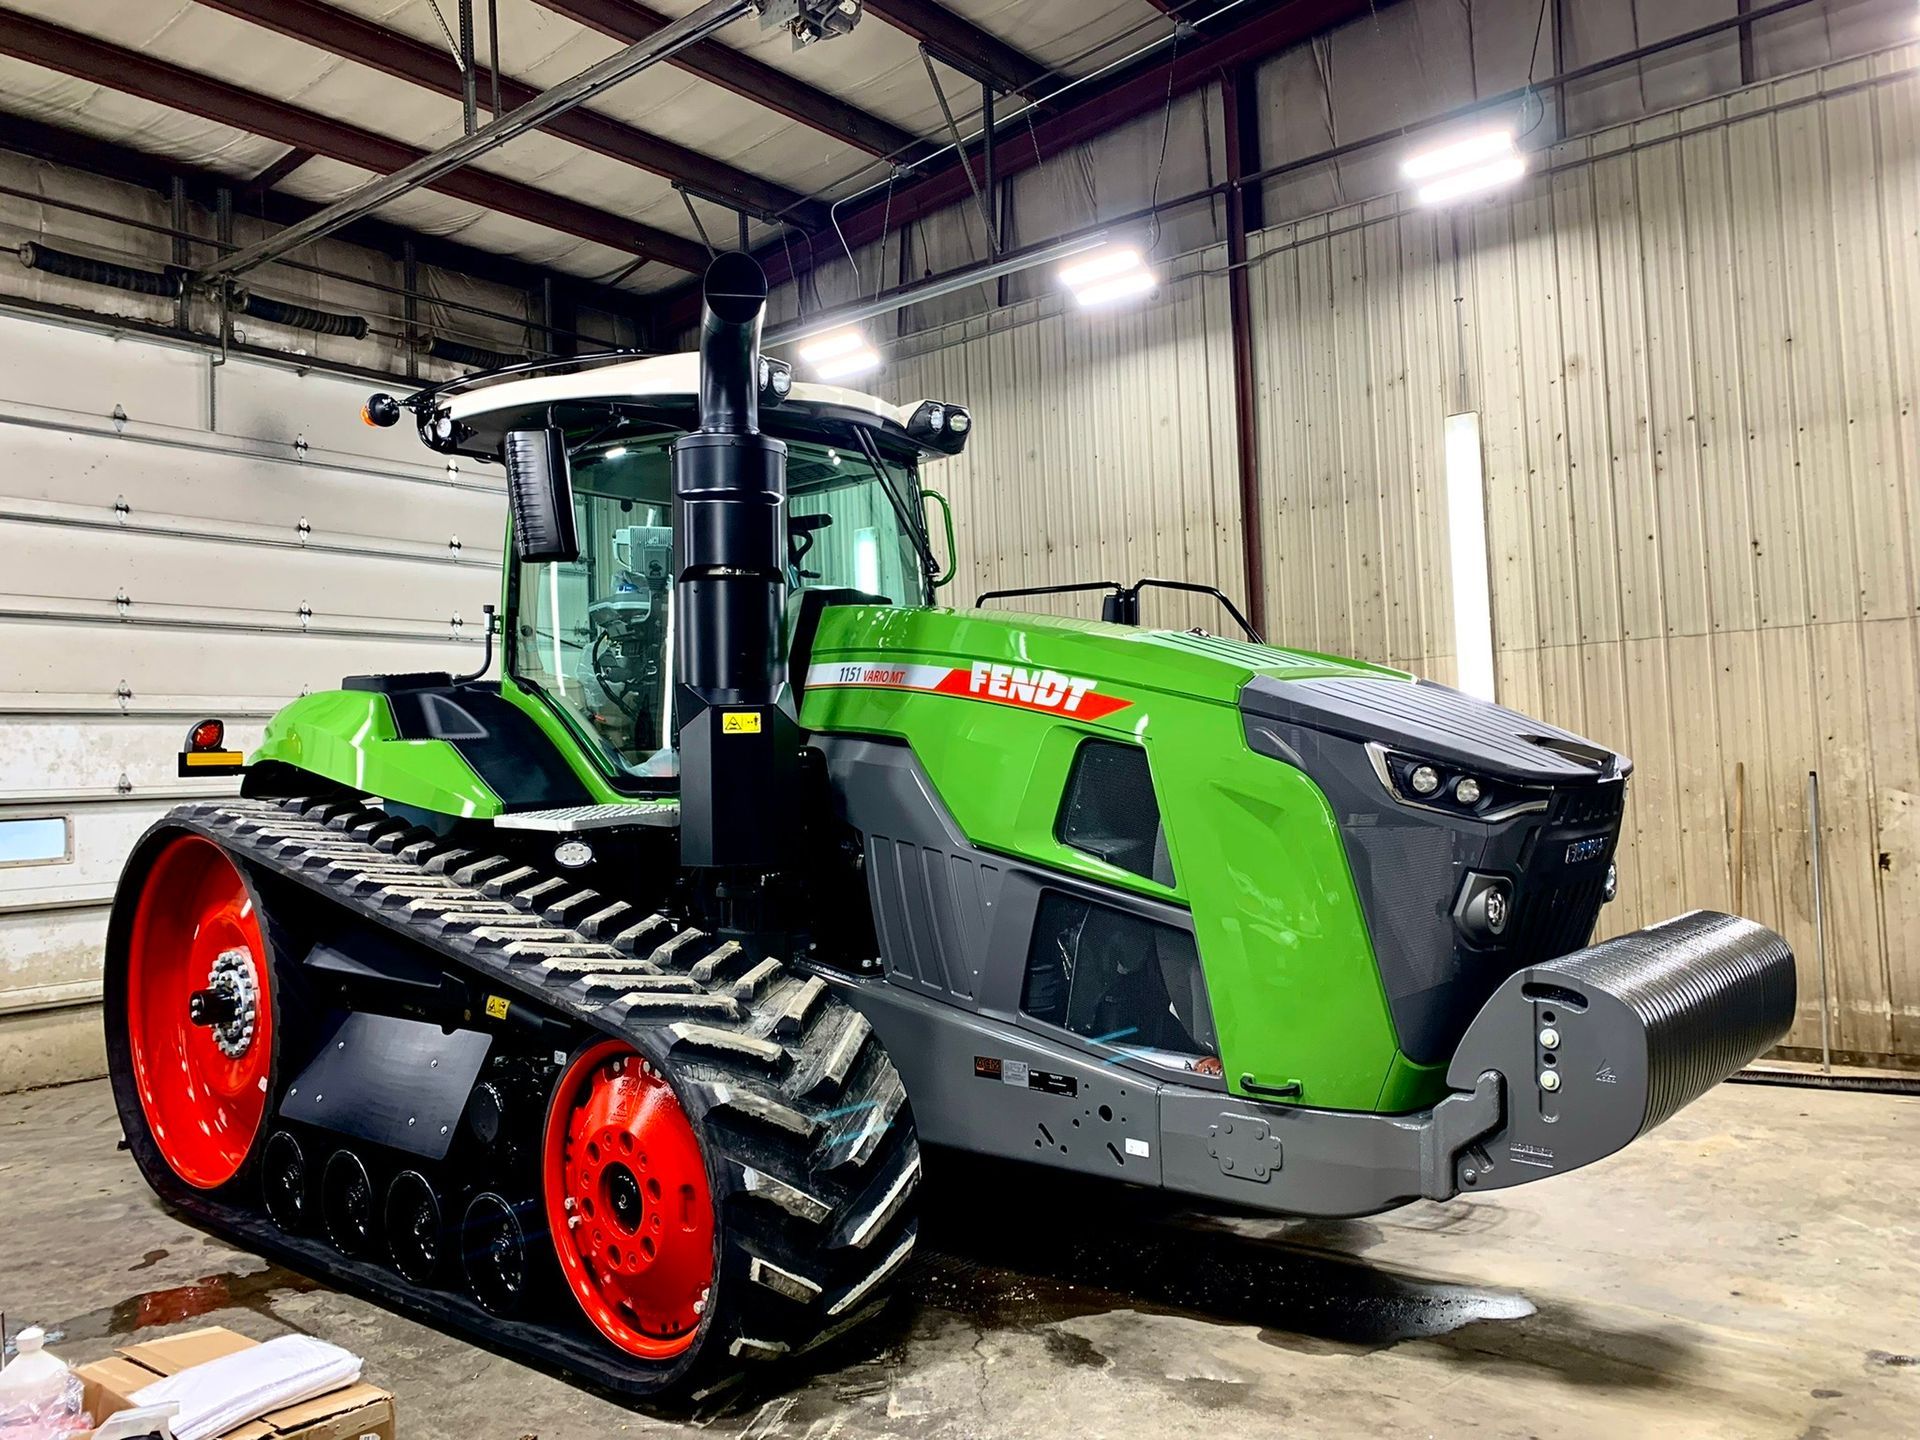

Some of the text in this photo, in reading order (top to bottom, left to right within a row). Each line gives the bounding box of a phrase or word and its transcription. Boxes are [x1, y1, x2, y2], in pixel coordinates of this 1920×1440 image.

[839, 667, 905, 684] 1151 VARIO MT
[969, 661, 1097, 711] FENDT
